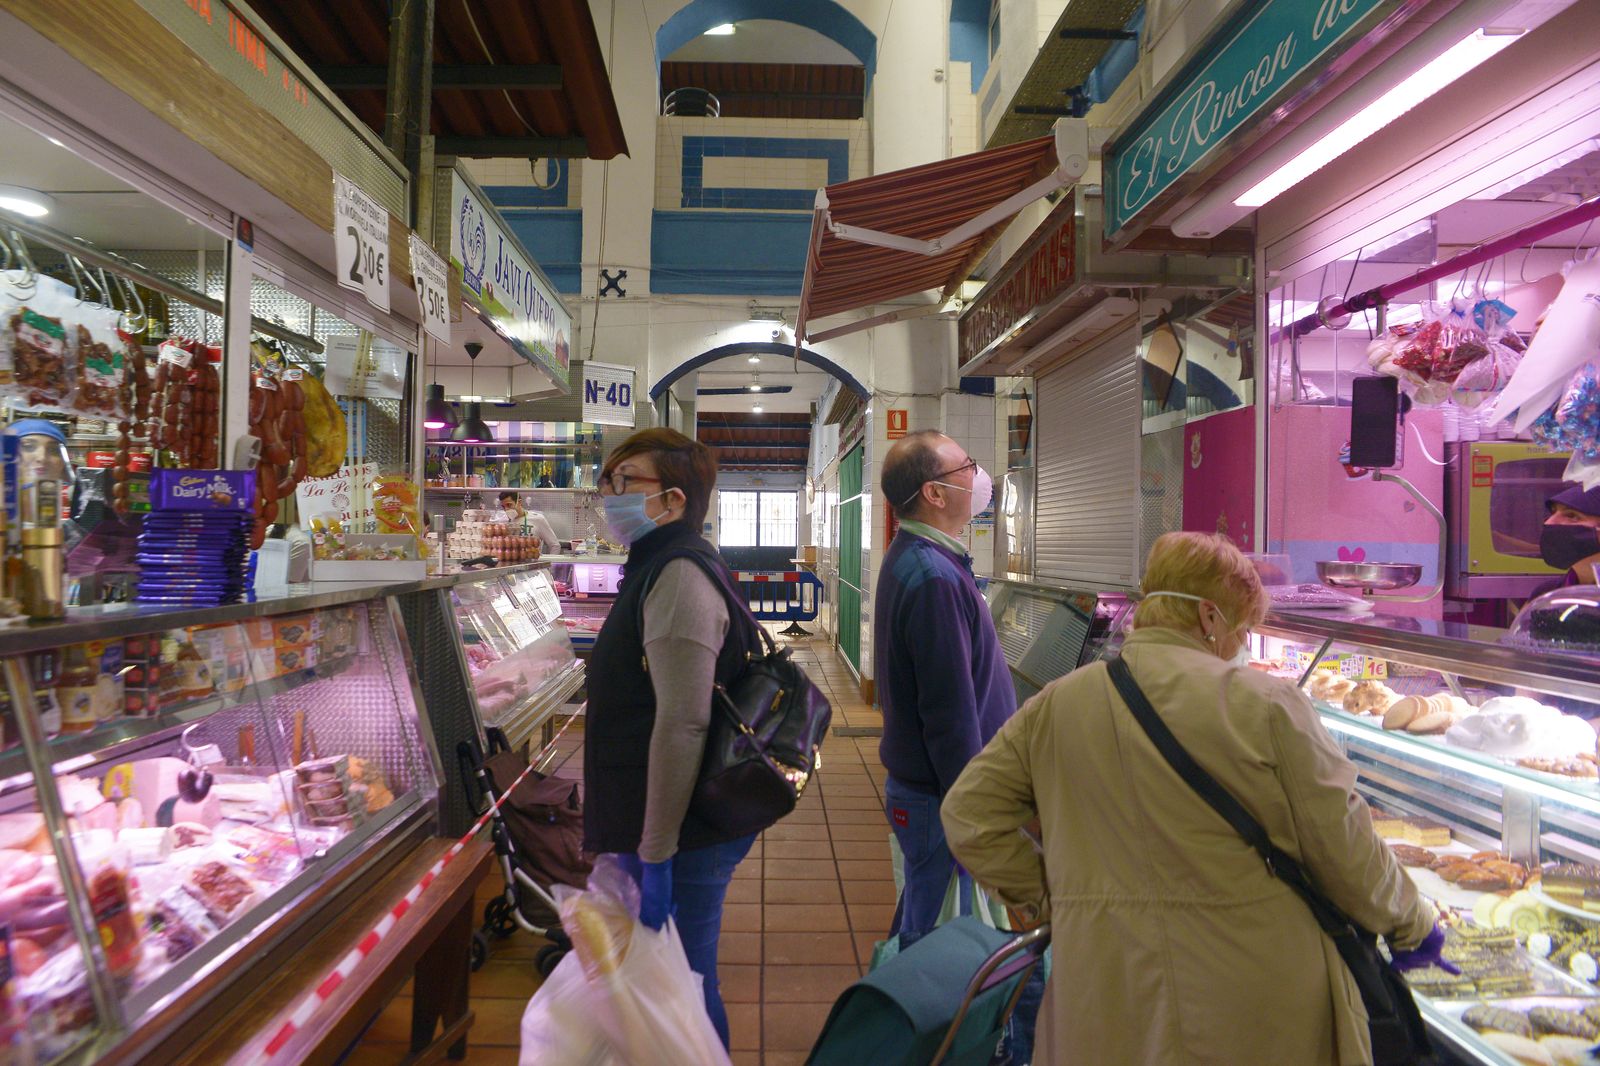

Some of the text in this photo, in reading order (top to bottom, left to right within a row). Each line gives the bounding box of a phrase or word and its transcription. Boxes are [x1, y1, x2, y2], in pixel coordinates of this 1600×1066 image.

[1124, 136, 1163, 209] El
[1166, 31, 1298, 173] Rincon
[495, 235, 520, 306] JAVI
[585, 379, 631, 407] N-40
[173, 481, 234, 499] Dairy Milk
[303, 484, 325, 497] La
[1368, 661, 1384, 676] 1€
